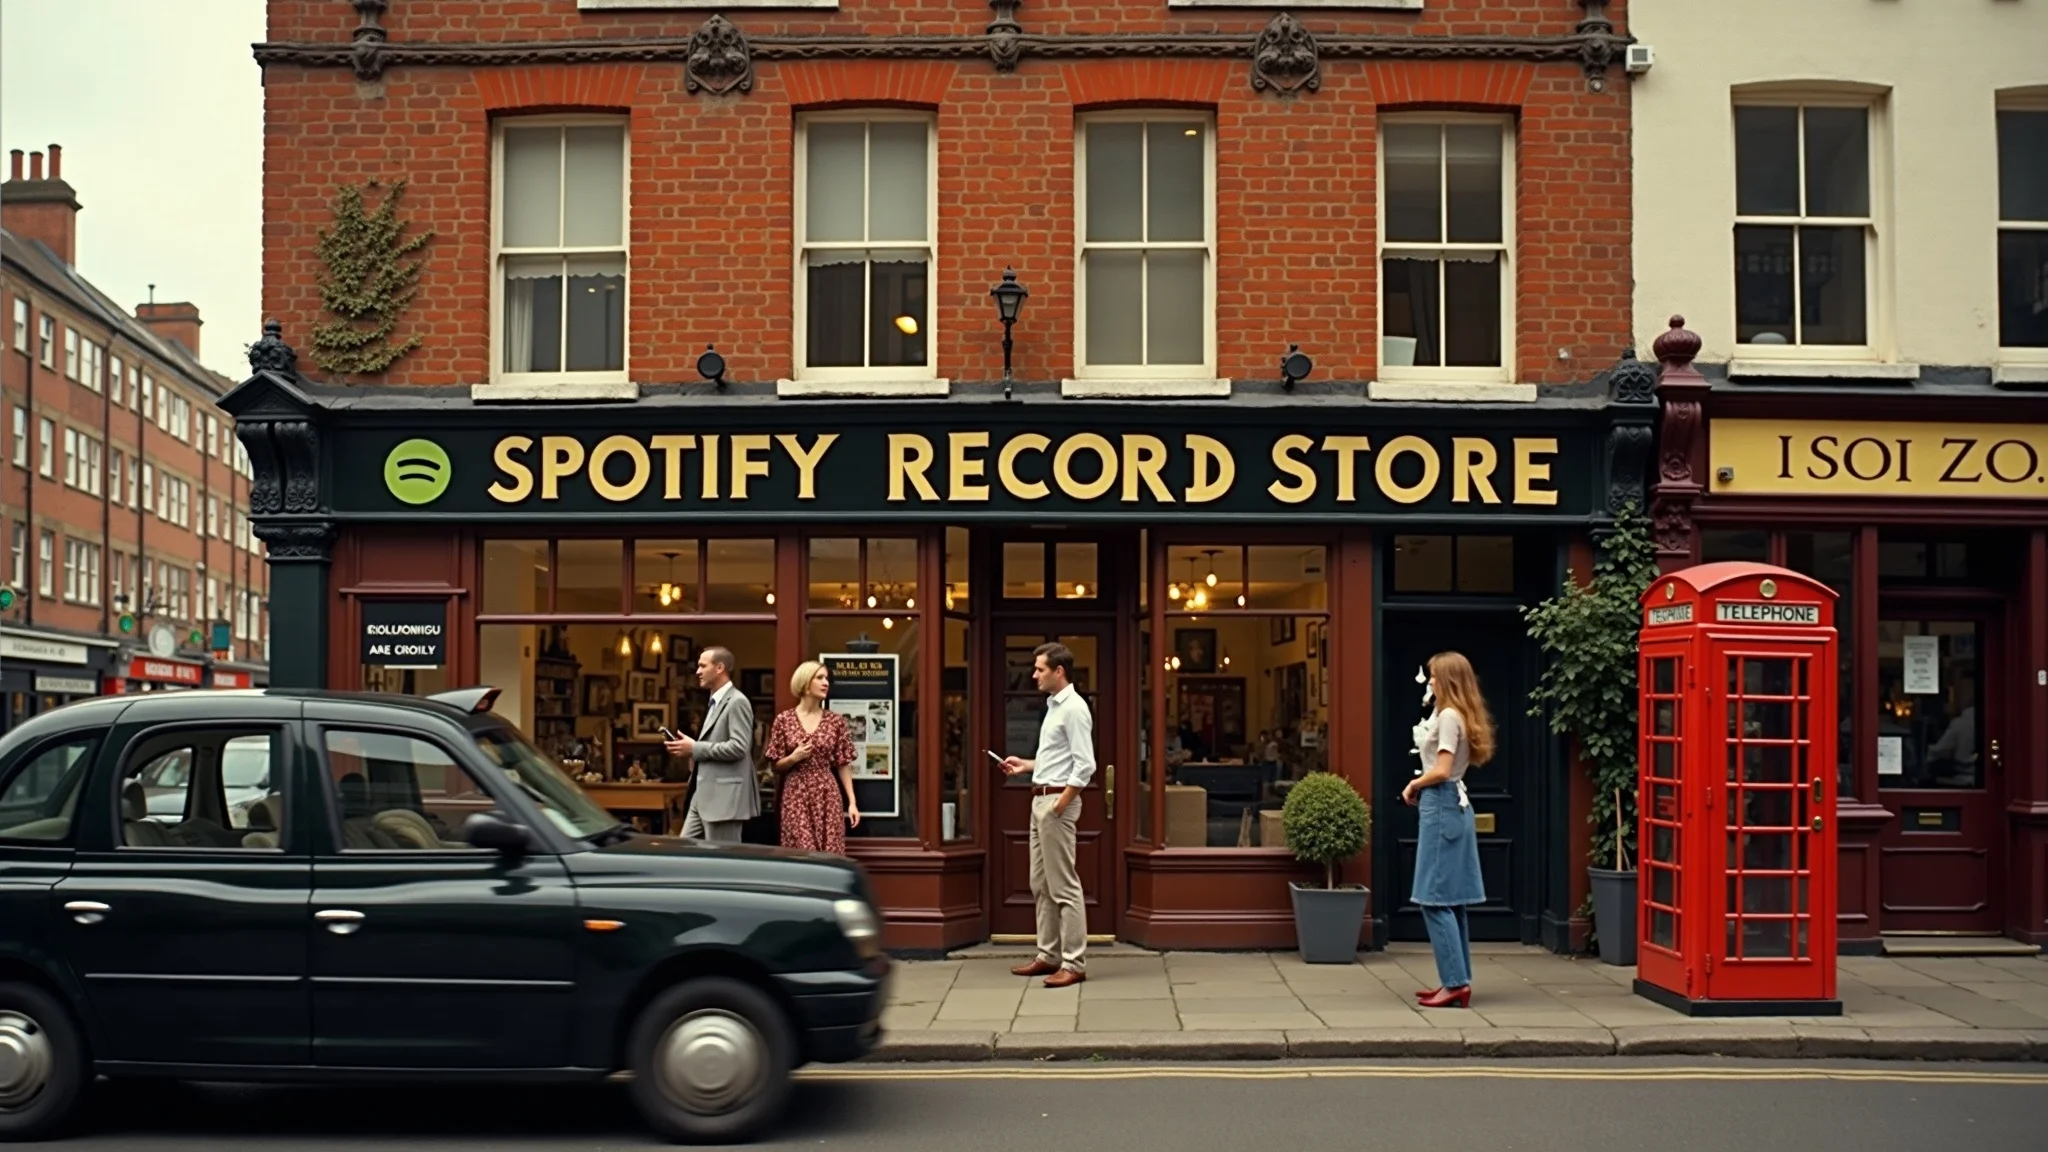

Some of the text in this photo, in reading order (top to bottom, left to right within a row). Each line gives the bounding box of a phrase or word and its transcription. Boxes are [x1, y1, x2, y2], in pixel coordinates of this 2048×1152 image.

[488, 432, 1558, 505] SPOTIFY RECORD STORE
[1939, 438, 2045, 484] ZO.
[1722, 604, 1815, 621] TELEPHONE
